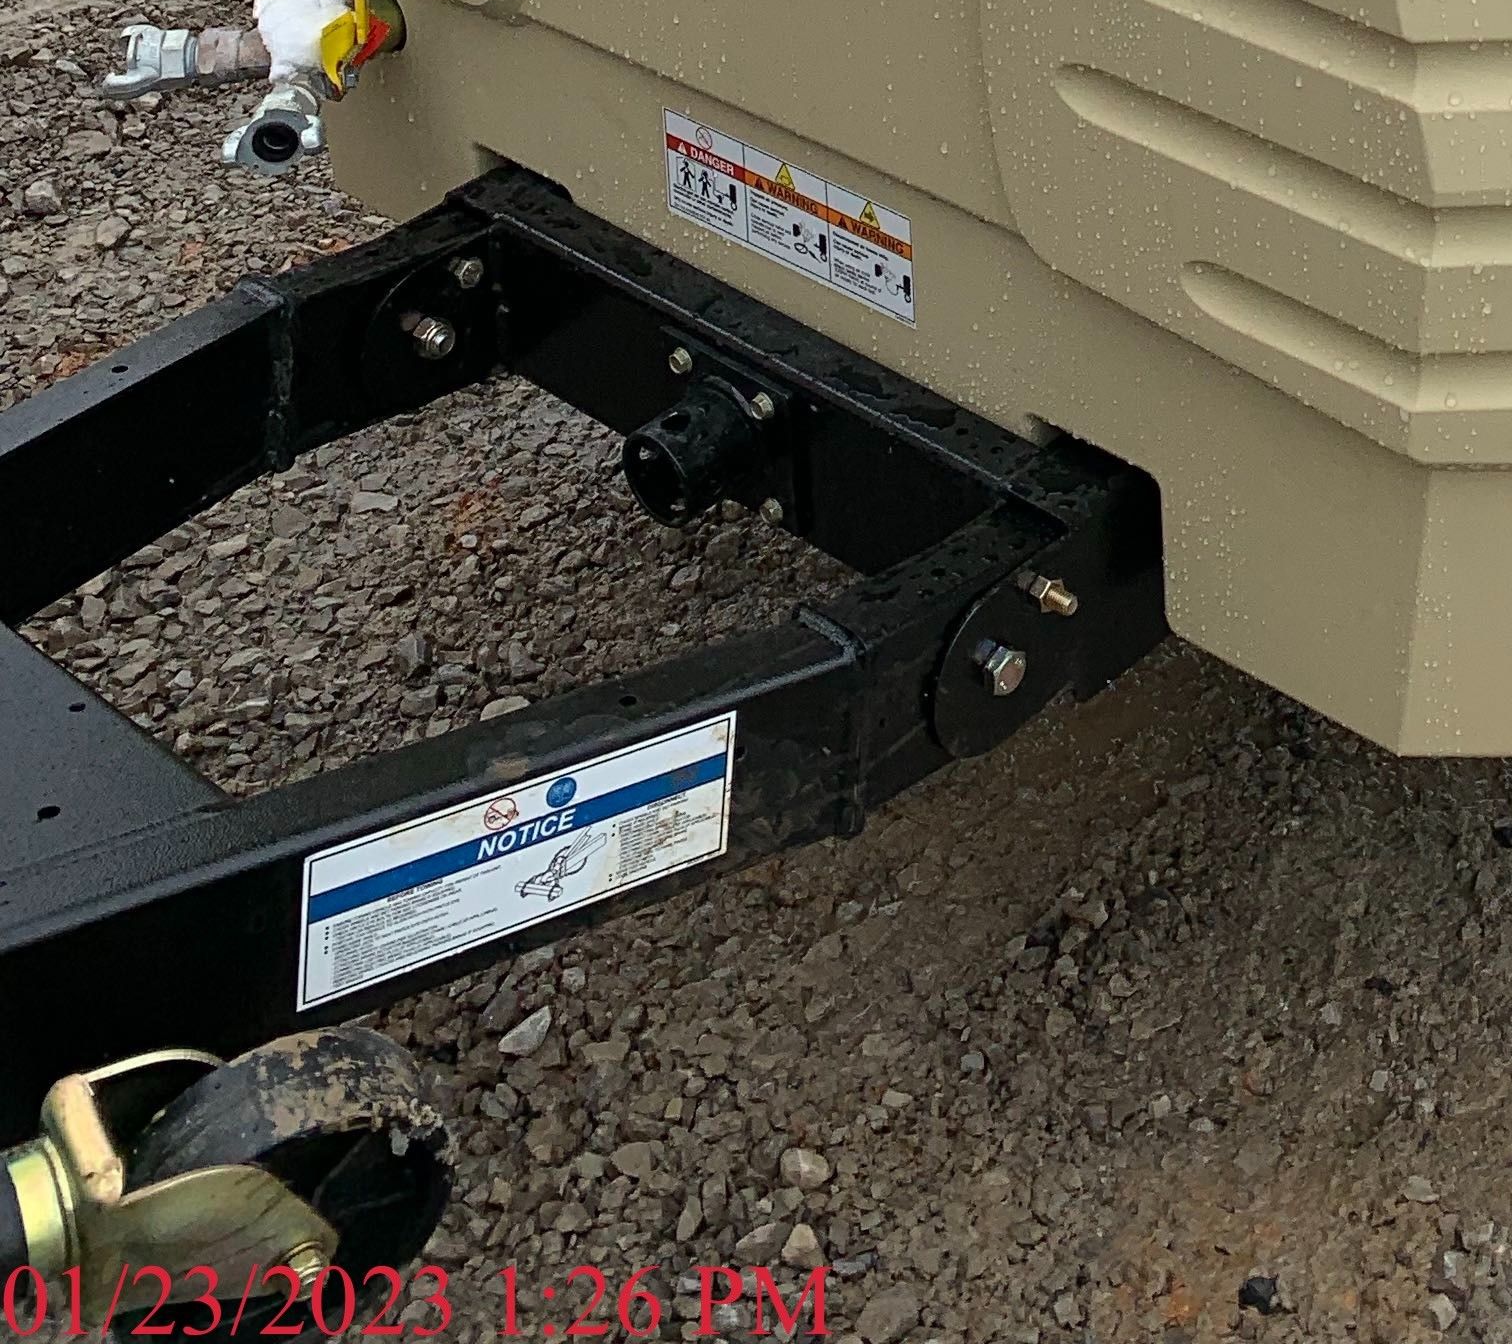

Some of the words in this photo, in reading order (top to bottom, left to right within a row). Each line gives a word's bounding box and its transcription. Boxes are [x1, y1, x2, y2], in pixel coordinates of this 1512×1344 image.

[690, 147, 734, 176] DANGER
[767, 181, 818, 215] WARNING
[852, 223, 904, 254] WARNING
[477, 808, 576, 861] NOTICE
